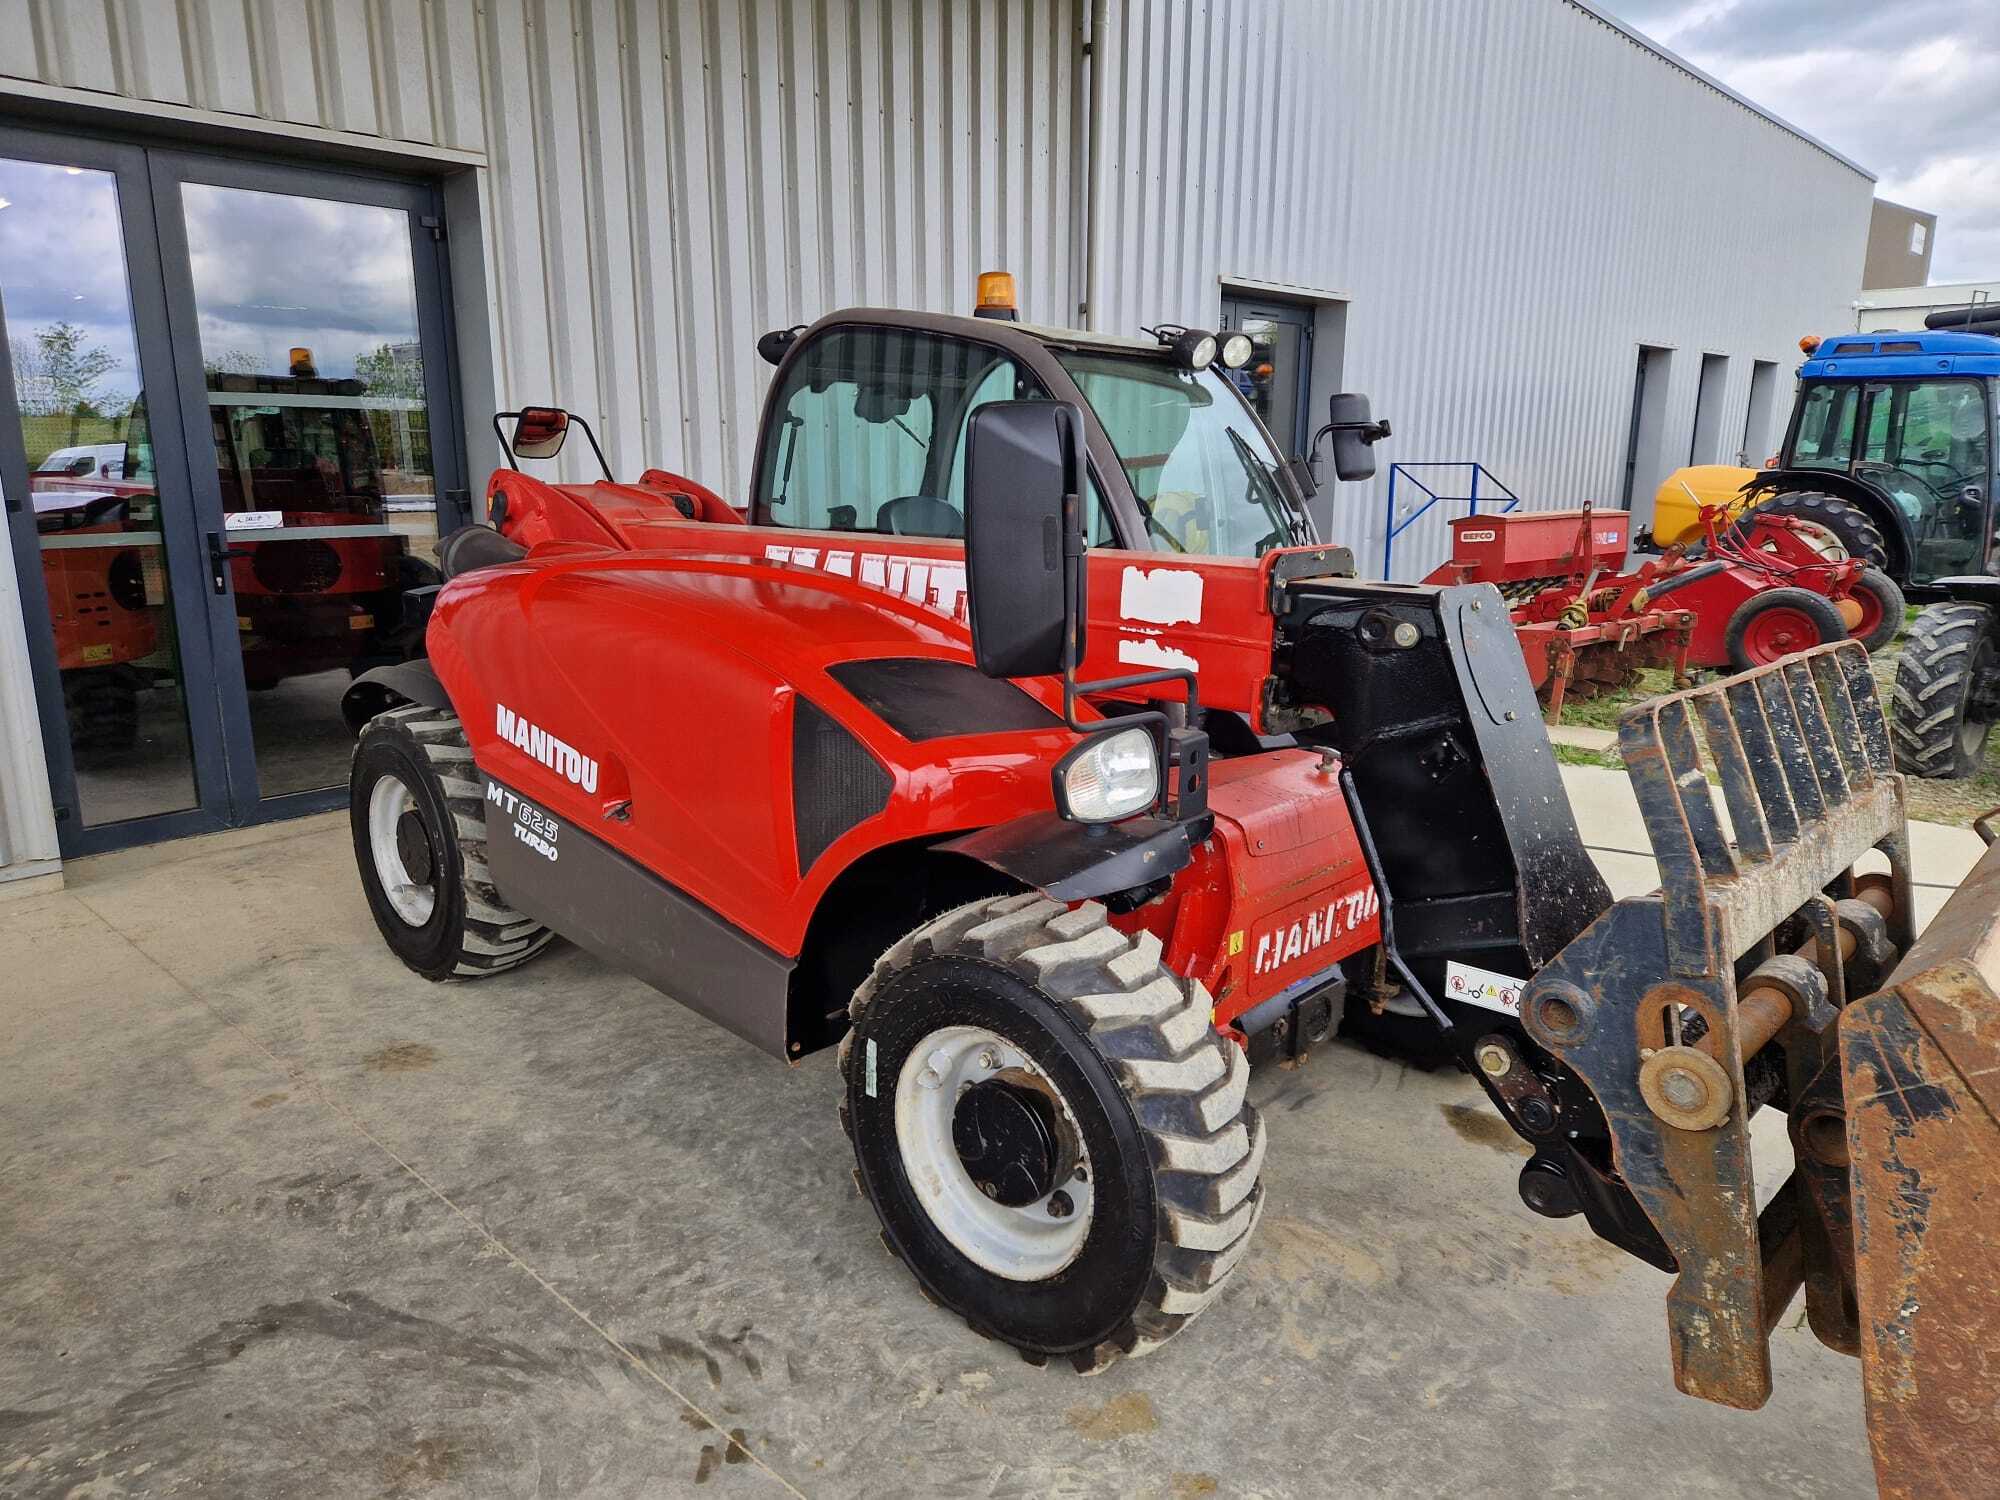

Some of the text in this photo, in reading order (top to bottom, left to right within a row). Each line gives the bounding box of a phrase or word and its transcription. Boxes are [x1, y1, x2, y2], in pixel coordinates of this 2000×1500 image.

[497, 703, 598, 794] MANITOU
[487, 781, 559, 842] MT 625
[513, 822, 558, 862] TURBO
